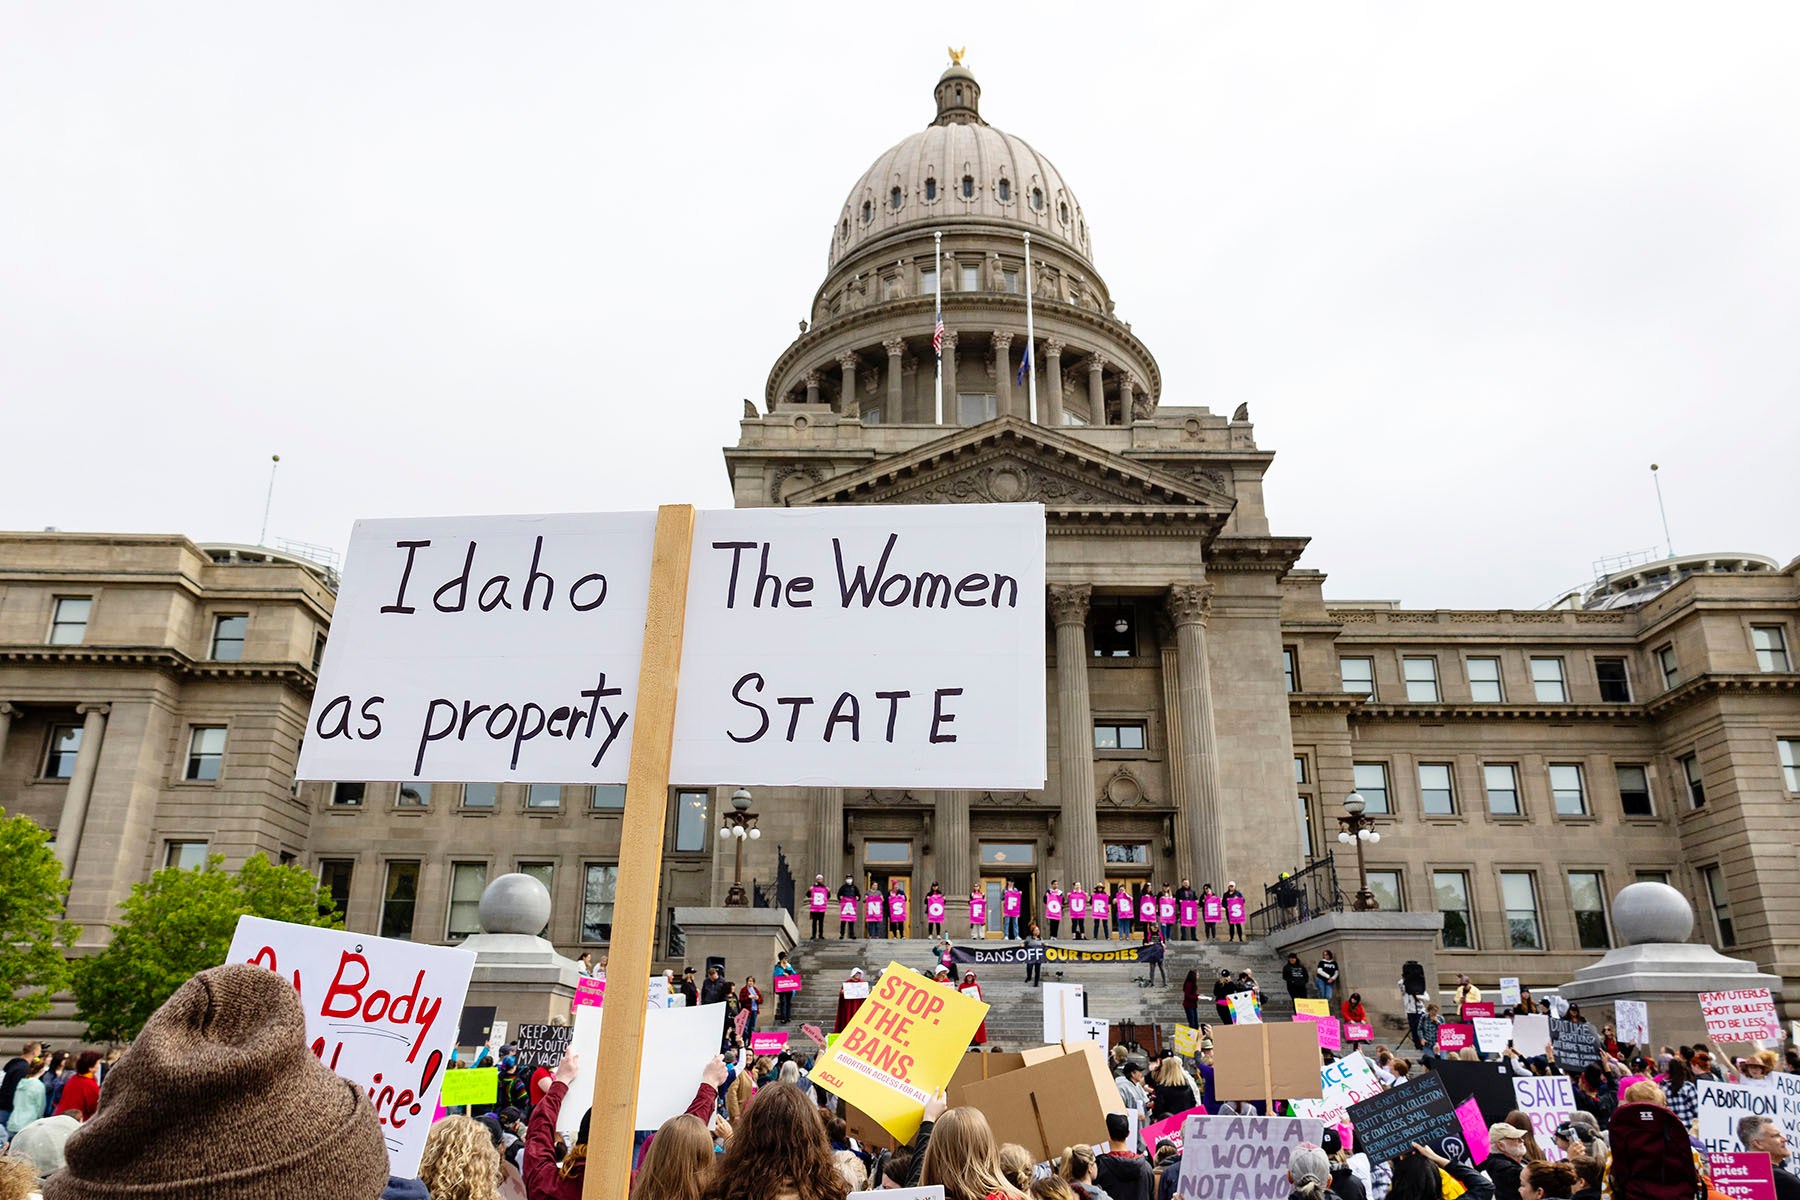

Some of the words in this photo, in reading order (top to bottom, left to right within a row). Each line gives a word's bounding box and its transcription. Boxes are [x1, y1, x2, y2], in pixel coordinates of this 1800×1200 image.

[381, 536, 608, 614] Idaho
[712, 541, 815, 609] The
[832, 533, 1018, 609] Women
[727, 672, 964, 744] STATE
[316, 695, 386, 741] as
[414, 673, 629, 777] property
[975, 950, 1014, 962] BANS
[1015, 948, 1043, 962] OFF
[1045, 949, 1079, 961] OUR
[1082, 949, 1138, 962] BODIES
[321, 950, 443, 1063] Body
[879, 975, 945, 1026] STOP.
[1700, 993, 1709, 1002] IF
[1709, 991, 1726, 1002] MY
[1727, 988, 1769, 1000] UTERUS
[1702, 1005, 1730, 1016] SHOT
[1732, 1002, 1775, 1014] BULLETS
[520, 1024, 549, 1040] KEEP
[863, 999, 915, 1048] THE.
[1728, 1018, 1741, 1029] BE
[1742, 1017, 1767, 1028] LESS
[517, 1039, 544, 1051] LAWS
[1710, 1030, 1769, 1043] REGULATED
[517, 1051, 536, 1065] MY
[537, 1051, 564, 1067] VAGI
[842, 1026, 915, 1085] BANS.
[818, 1070, 844, 1089] ACLU
[837, 1053, 873, 1078] ABORTION
[872, 1069, 899, 1090] ACCESS
[898, 1081, 913, 1096] FOR
[912, 1089, 927, 1103] ALL
[1320, 1062, 1353, 1089] ICE
[1397, 1087, 1414, 1099] ONE
[1413, 1077, 1439, 1094] LARGE
[1385, 1104, 1401, 1118] BUT
[1399, 1104, 1408, 1113] A
[1406, 1088, 1444, 1108] COLLECTION
[1517, 1078, 1573, 1108] SAVE
[1701, 1087, 1777, 1115] ABORTION
[1192, 1117, 1211, 1139] I
[1225, 1117, 1269, 1141] AM
[1283, 1119, 1304, 1141] A
[1360, 1132, 1371, 1144] OF
[1406, 1109, 1431, 1124] SMALL
[1427, 1116, 1437, 1127] UP
[1435, 1110, 1457, 1124] FROM
[1211, 1144, 1290, 1170] WOMA
[1370, 1151, 1384, 1163] THE
[1399, 1141, 1408, 1152] BY
[1711, 1153, 1735, 1164] this
[1713, 1165, 1749, 1177] priest
[1180, 1174, 1232, 1200] NOT
[1254, 1173, 1291, 1200] WO
[1715, 1184, 1725, 1194] is
[1725, 1185, 1753, 1196] pro-
